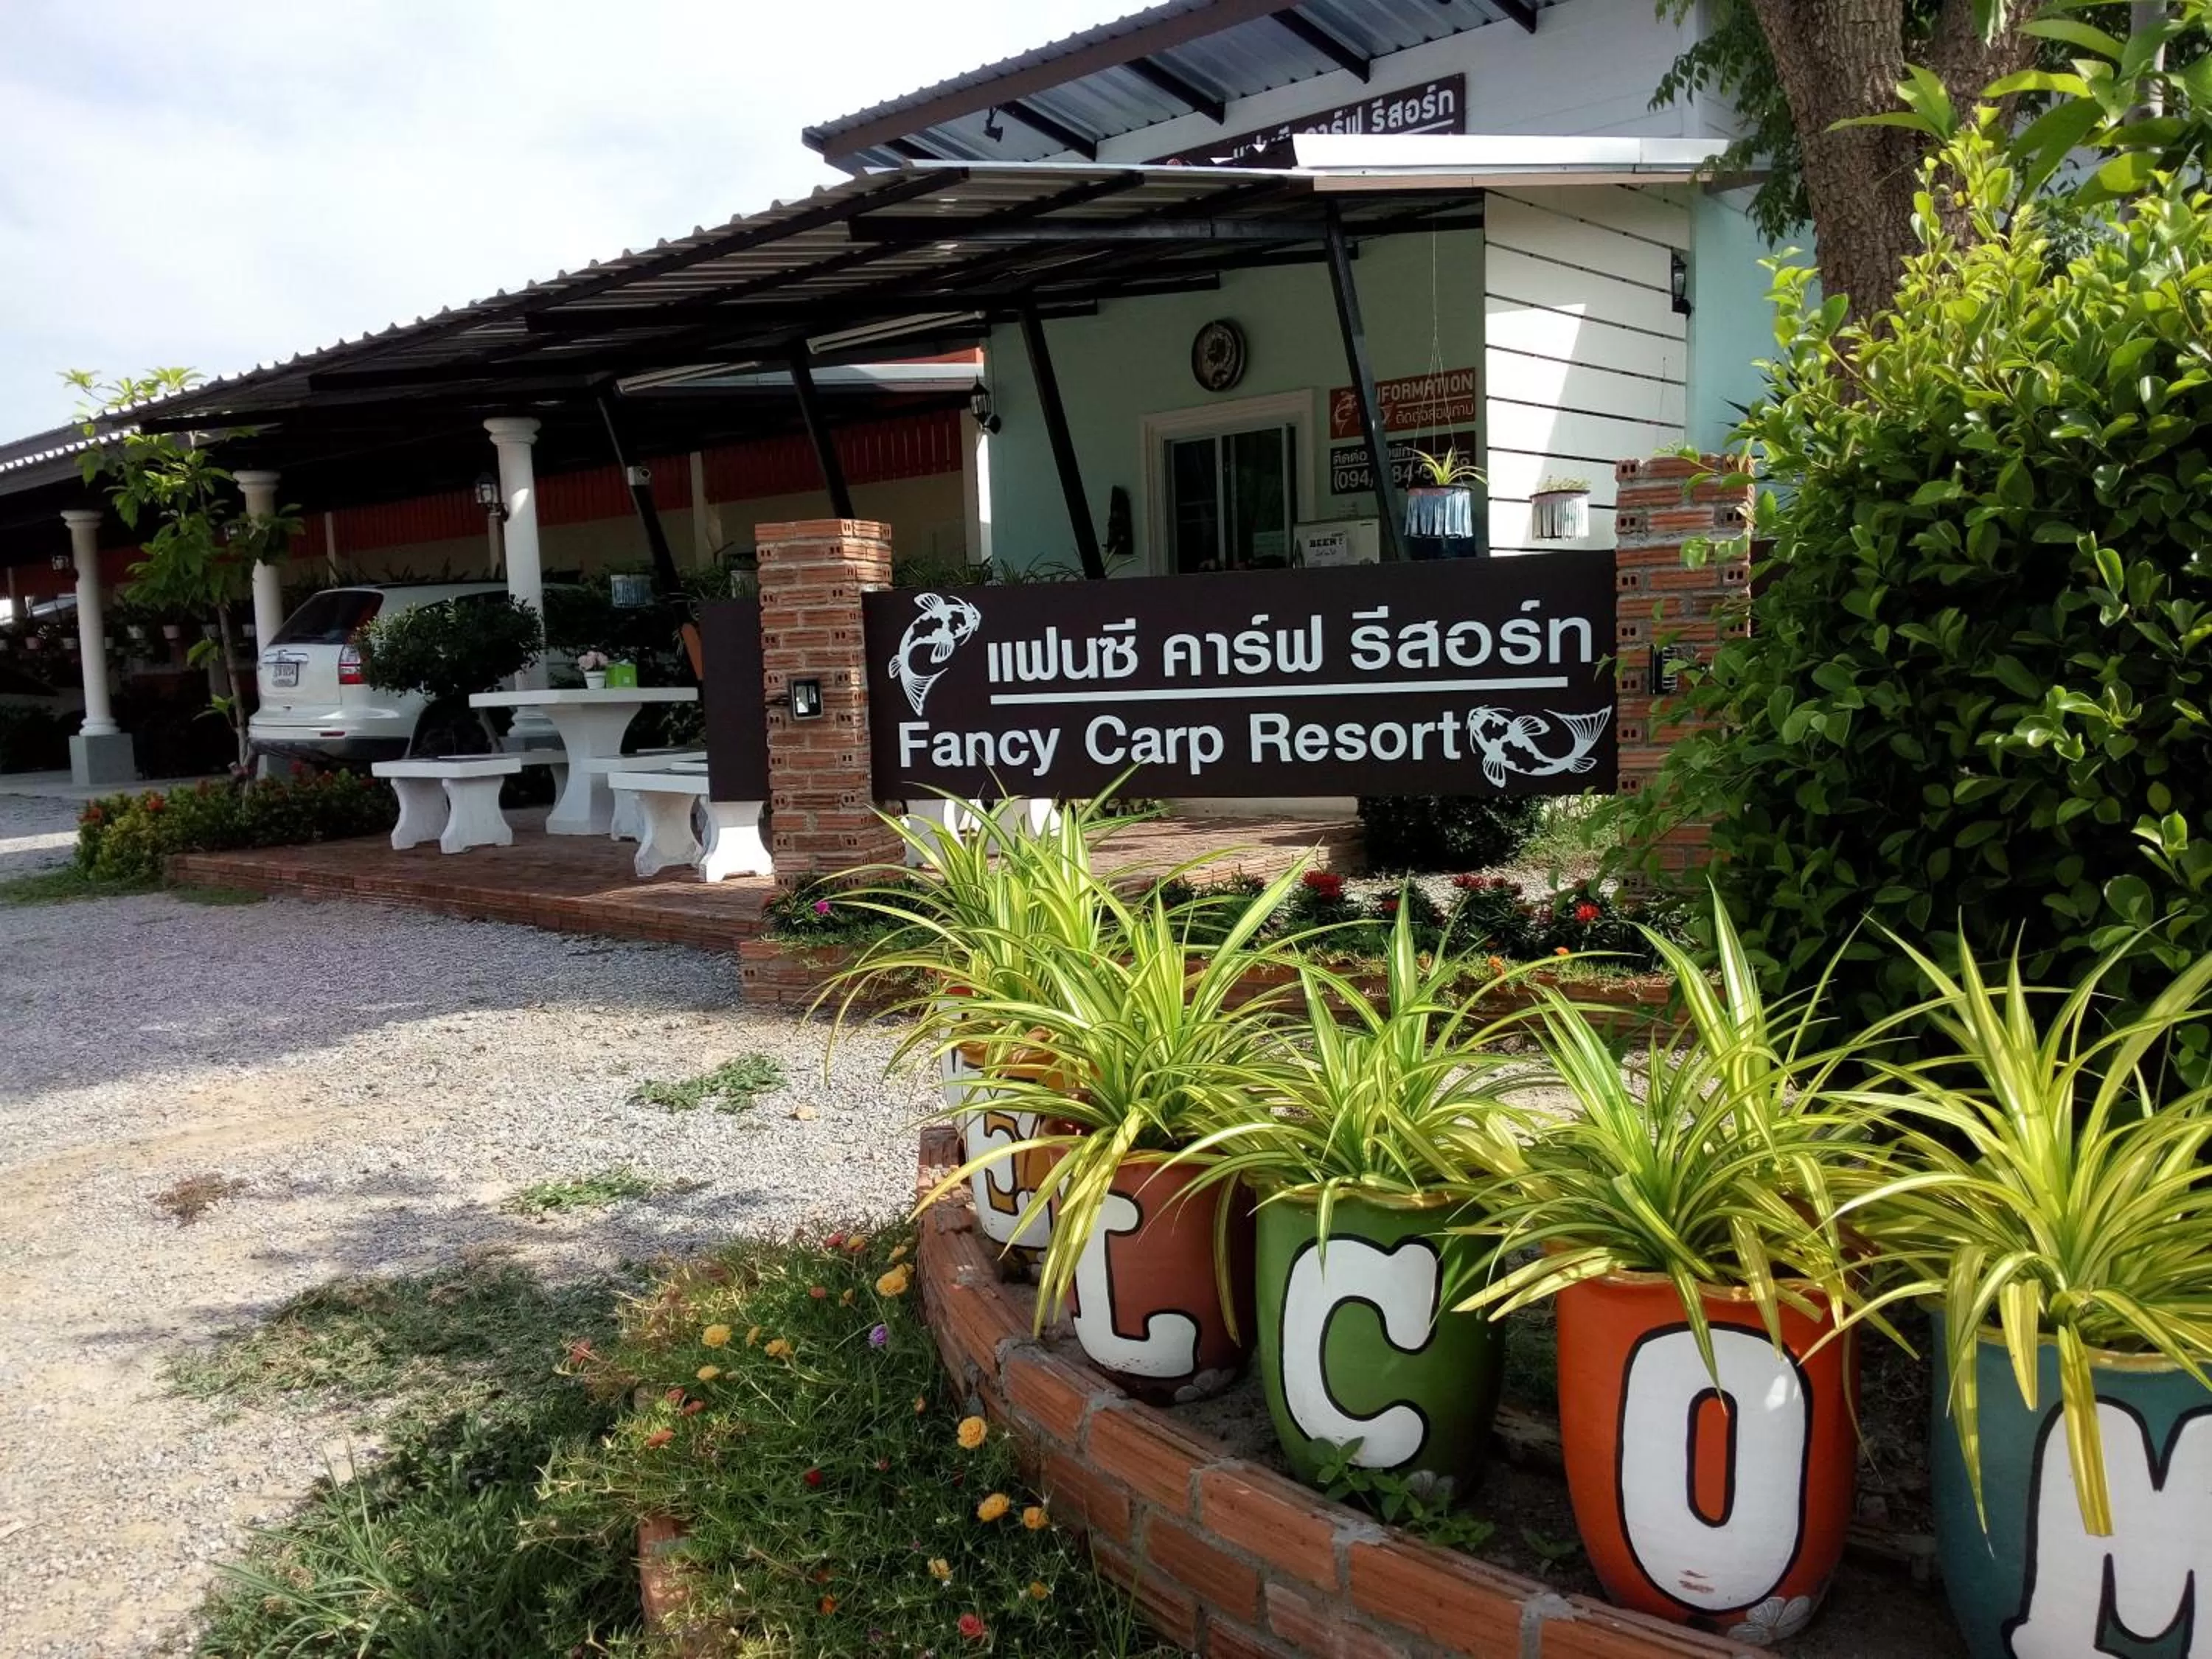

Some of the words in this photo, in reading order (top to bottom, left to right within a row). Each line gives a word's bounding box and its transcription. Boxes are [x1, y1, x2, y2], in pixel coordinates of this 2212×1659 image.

[1374, 373, 1474, 403] FORMATION
[987, 617, 1138, 683] แฟนซี
[1164, 613, 1323, 677] คาร์ฟ
[1350, 599, 1593, 670] รีสอร์ท
[899, 721, 1060, 776] Fancy
[1085, 714, 1224, 775] Carp
[1250, 712, 1461, 762] Resort
